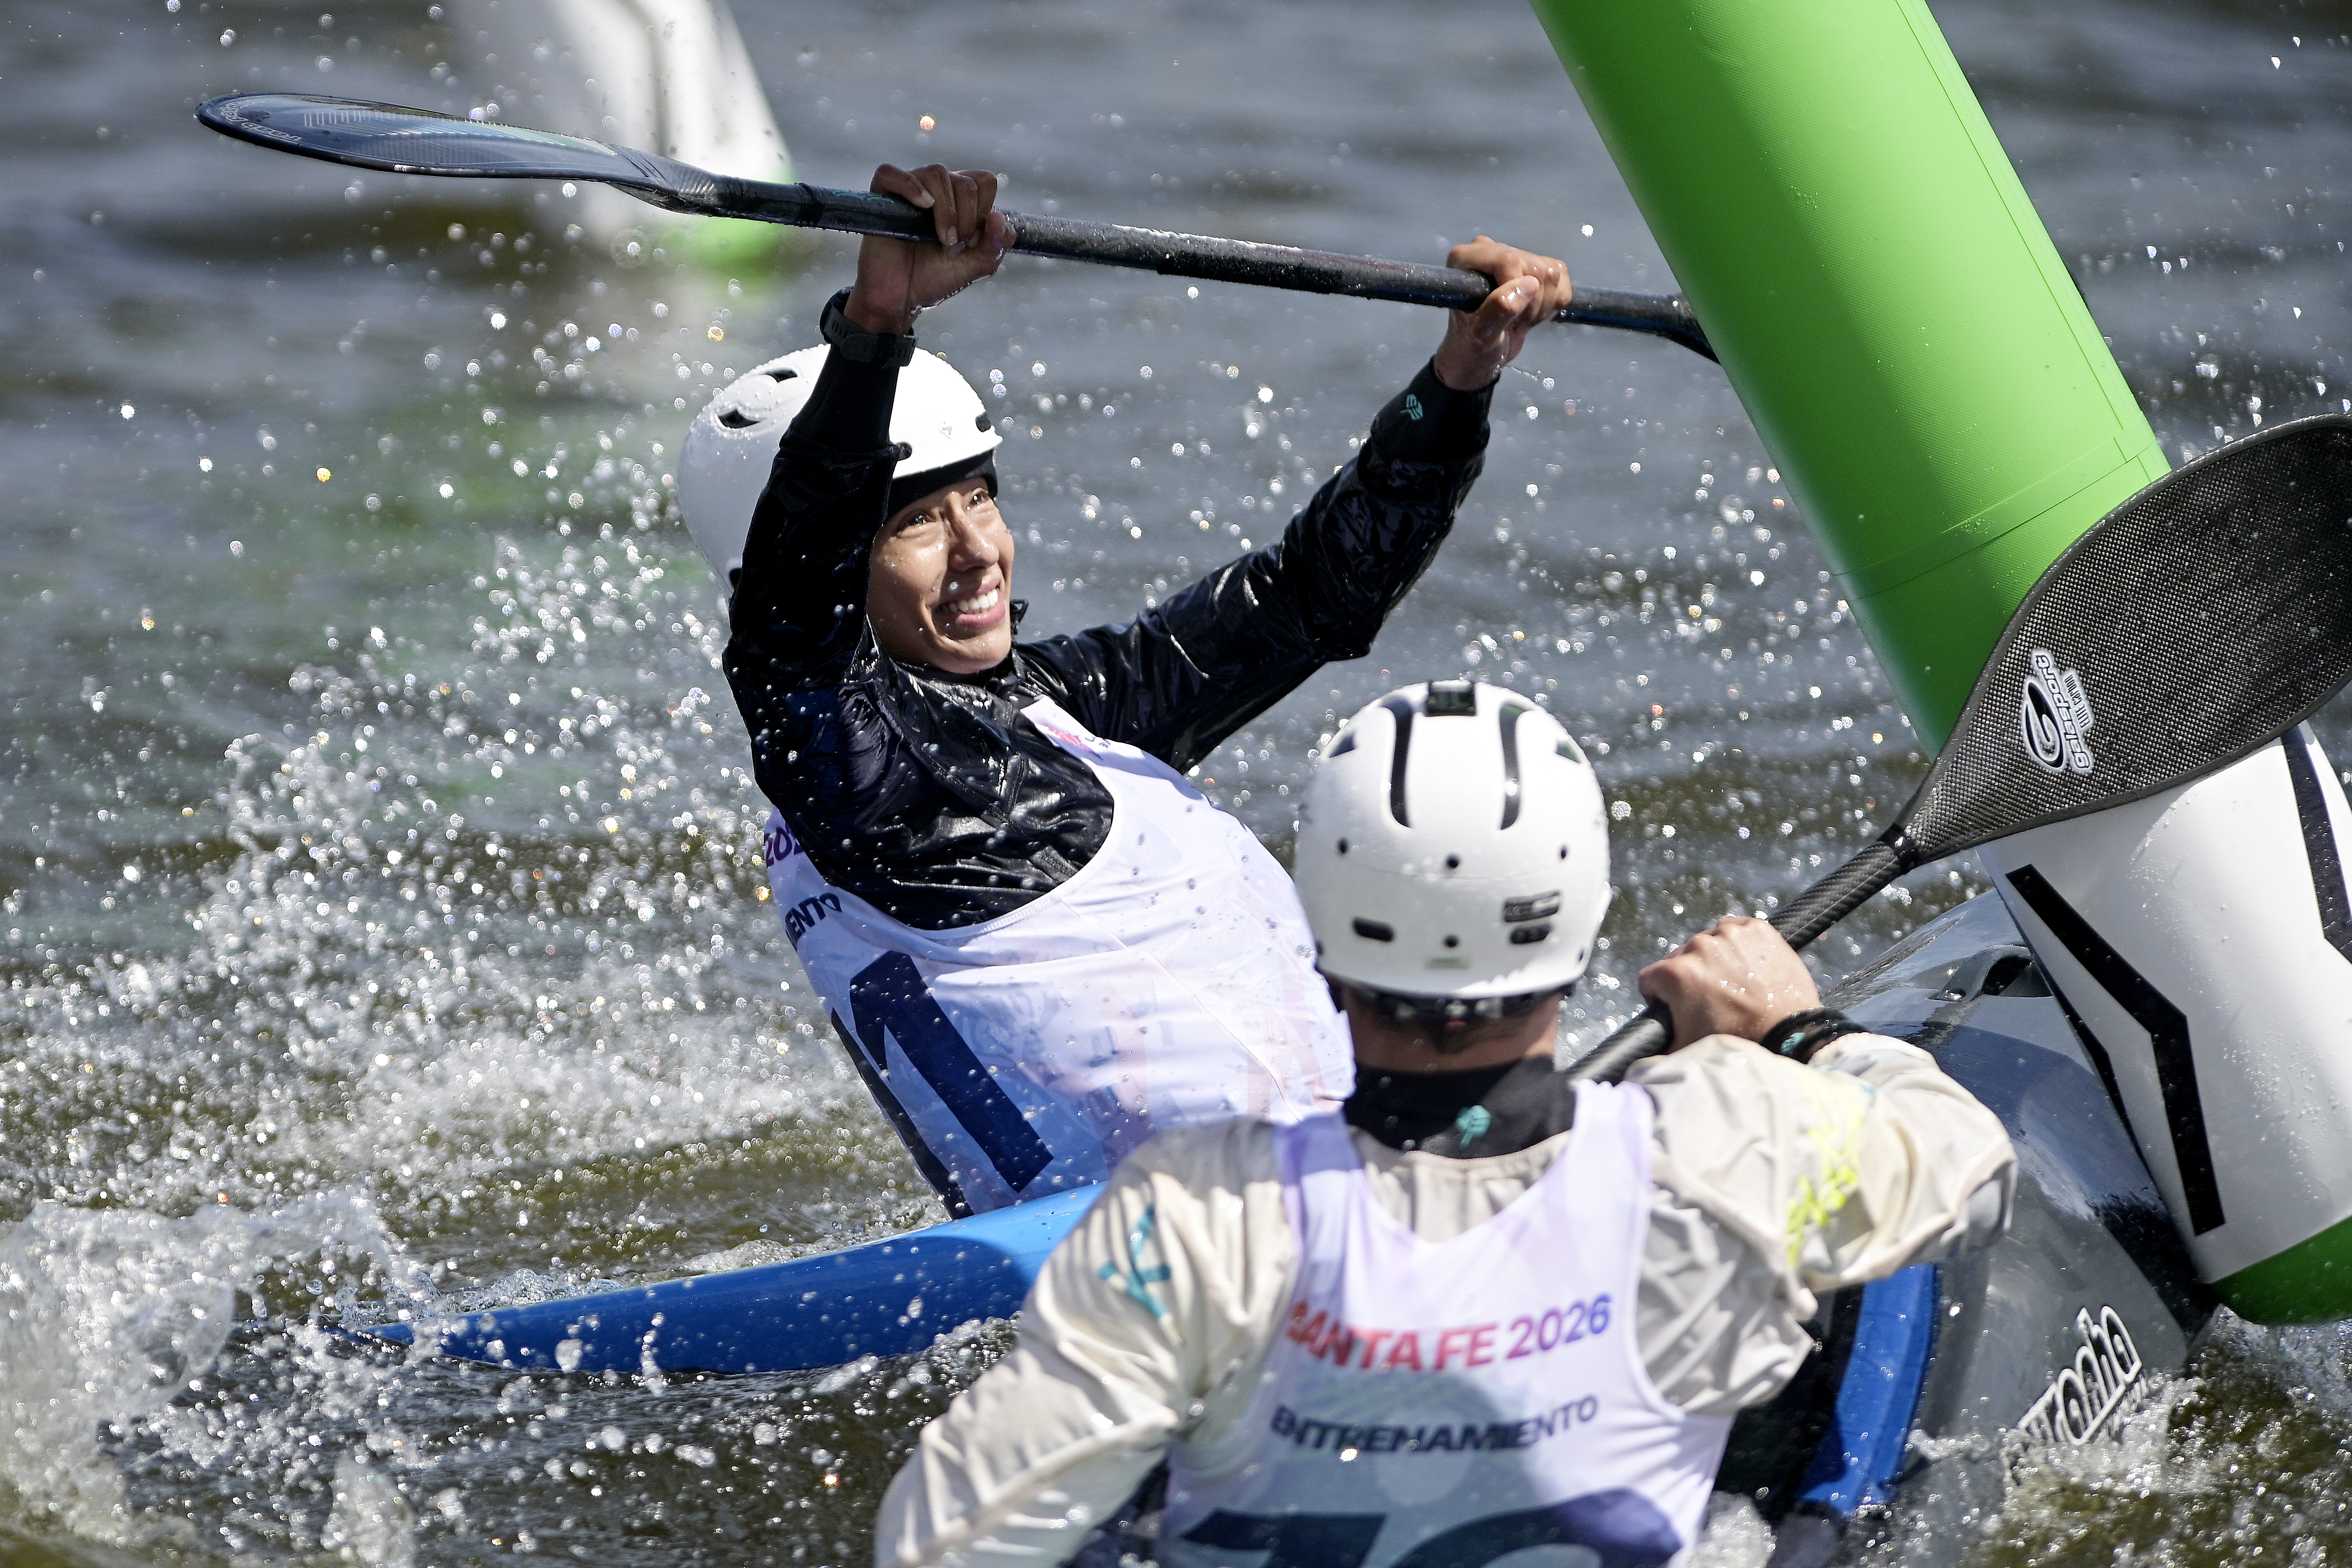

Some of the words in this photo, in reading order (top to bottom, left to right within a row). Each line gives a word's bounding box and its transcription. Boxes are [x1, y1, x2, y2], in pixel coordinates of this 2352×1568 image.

[2035, 655, 2090, 769] galasport
[2064, 674, 2082, 706] carbon
[2075, 703, 2090, 729] ELITE
[785, 892, 842, 951] ENTO
[1286, 1300, 1422, 1371] SANTA
[1434, 1323, 1499, 1372] FE
[1504, 1294, 1612, 1360] 2026
[1270, 1394, 1599, 1452] ENTRENAMIENTO
